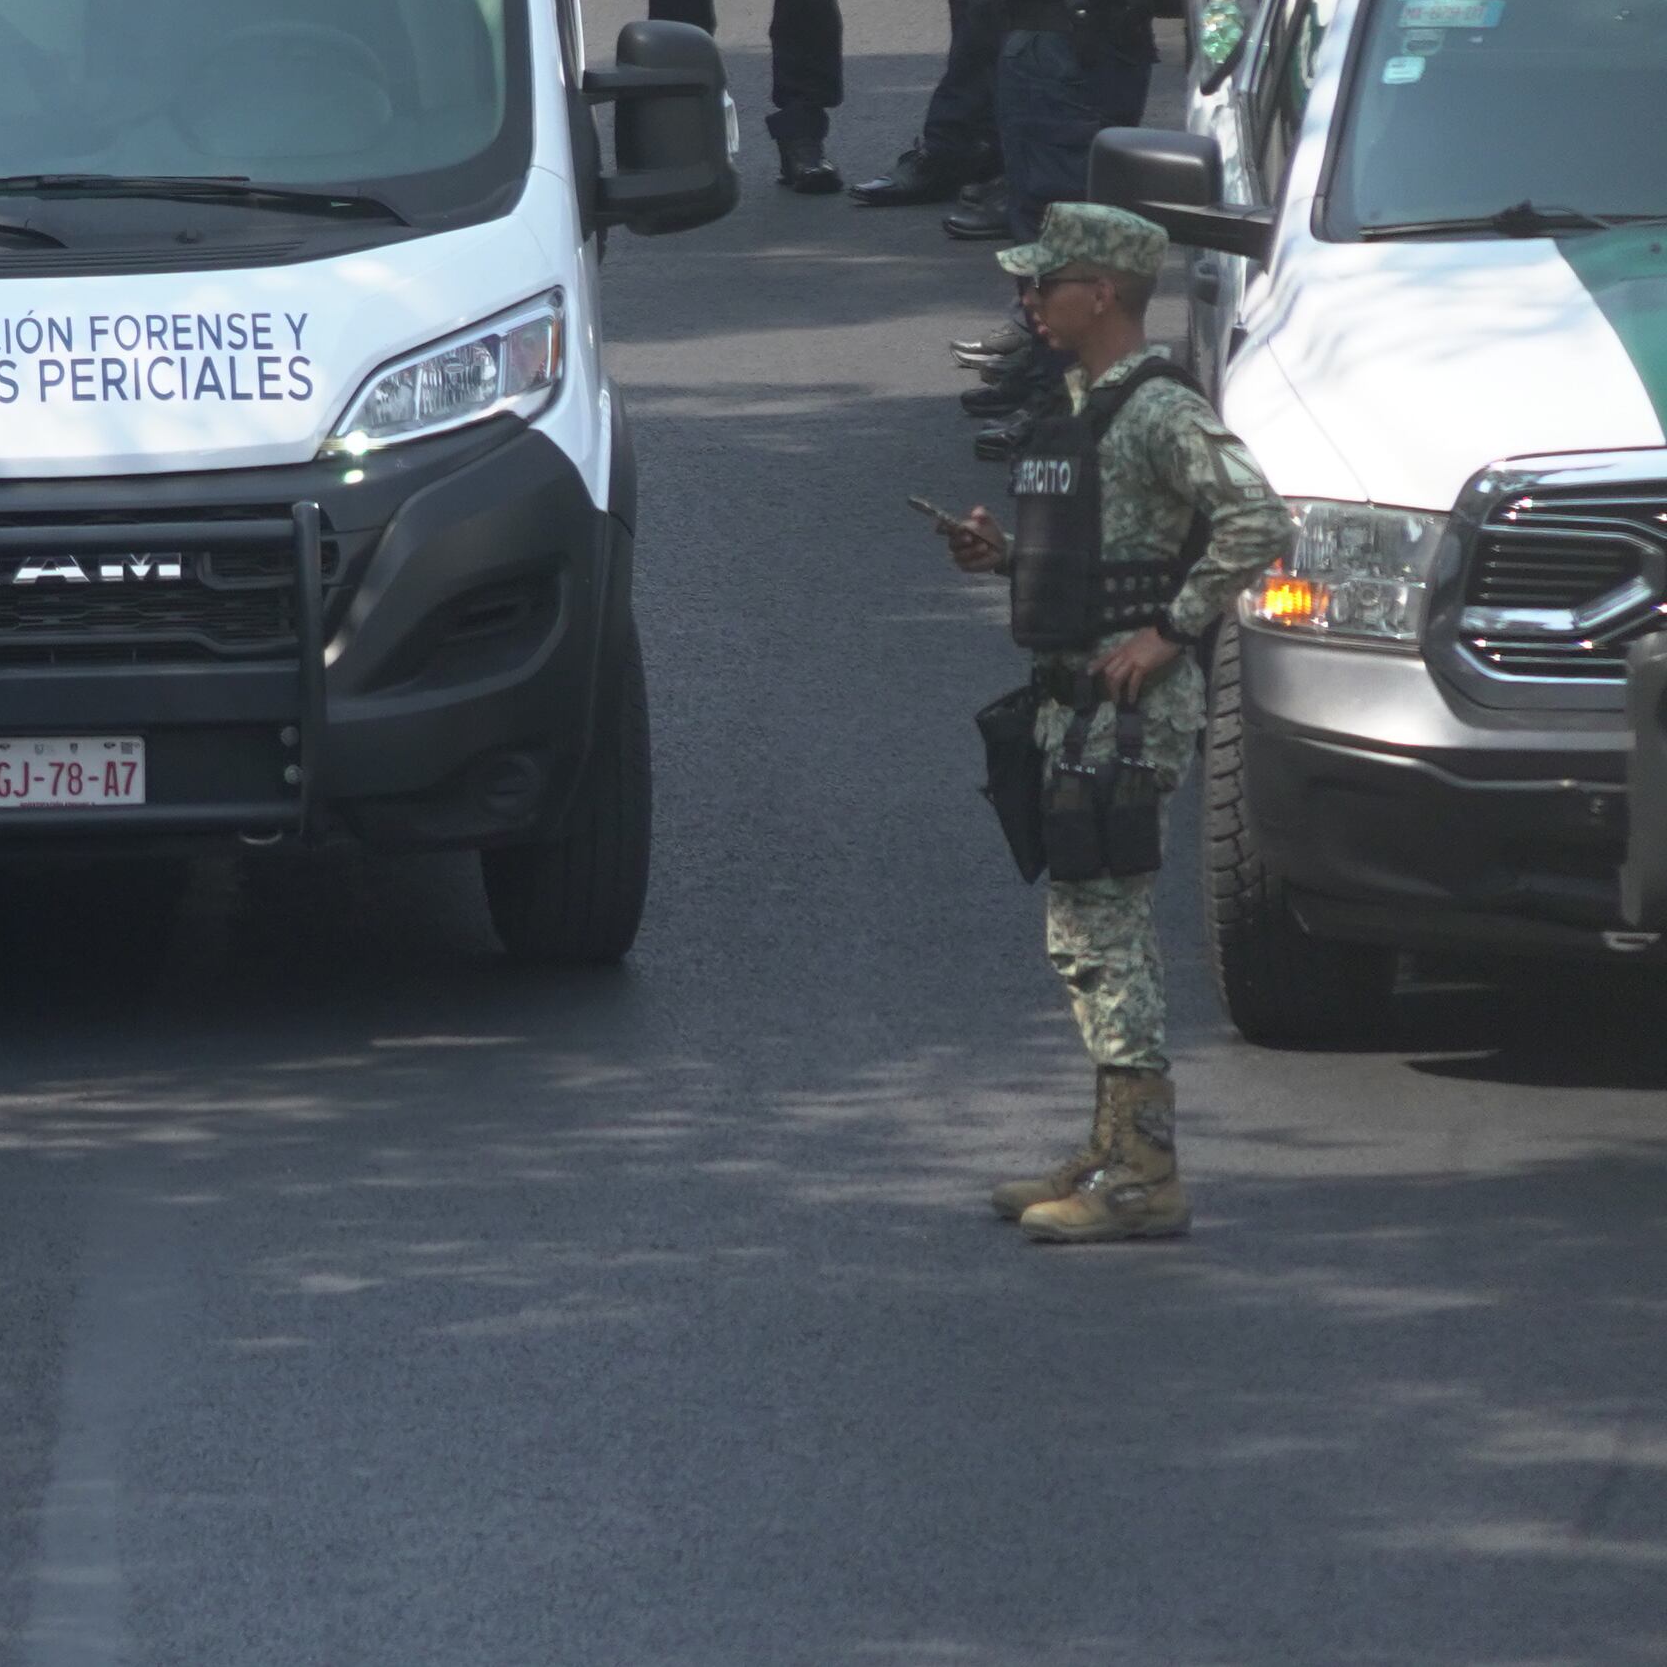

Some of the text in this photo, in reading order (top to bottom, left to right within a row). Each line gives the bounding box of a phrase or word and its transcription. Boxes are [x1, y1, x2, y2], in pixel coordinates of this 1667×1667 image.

[89, 313, 273, 353] FORENSE
[285, 313, 308, 351] Y
[38, 355, 314, 403] PERICIALES
